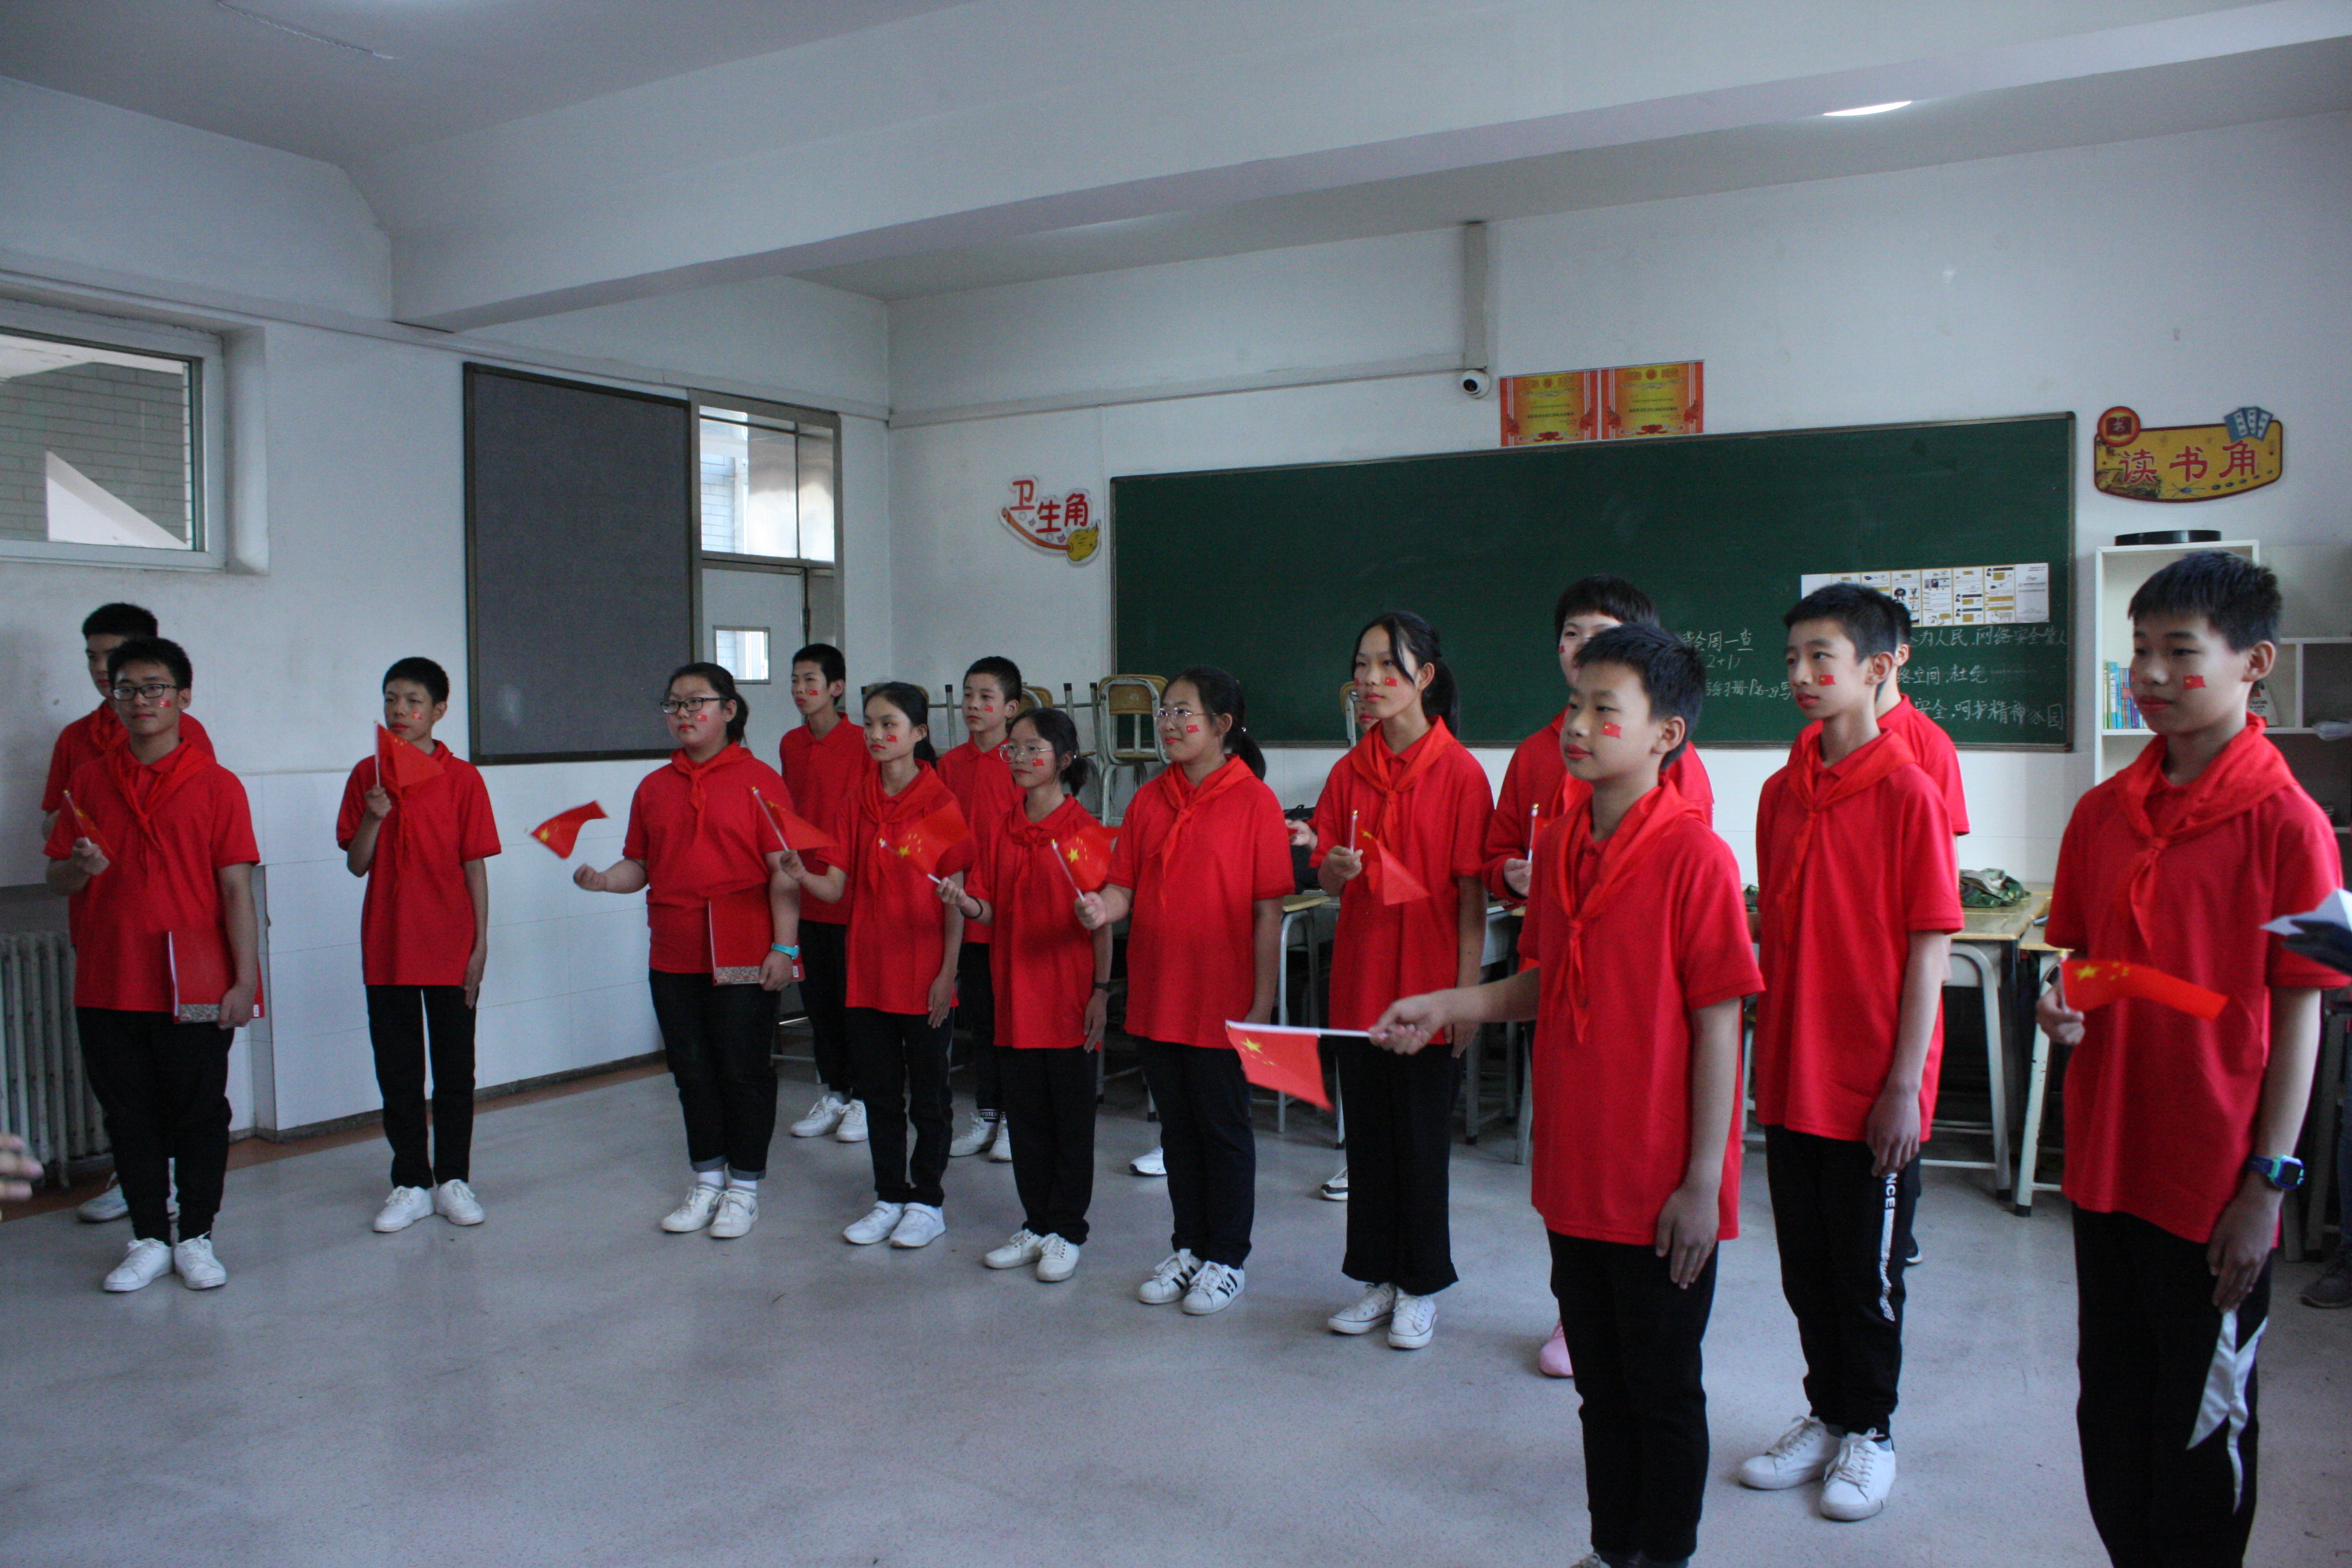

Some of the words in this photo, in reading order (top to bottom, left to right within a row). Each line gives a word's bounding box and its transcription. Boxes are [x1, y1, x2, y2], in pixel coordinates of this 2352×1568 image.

[2118, 440, 2256, 483] 读书角
[1010, 480, 1088, 533] 卫生角
